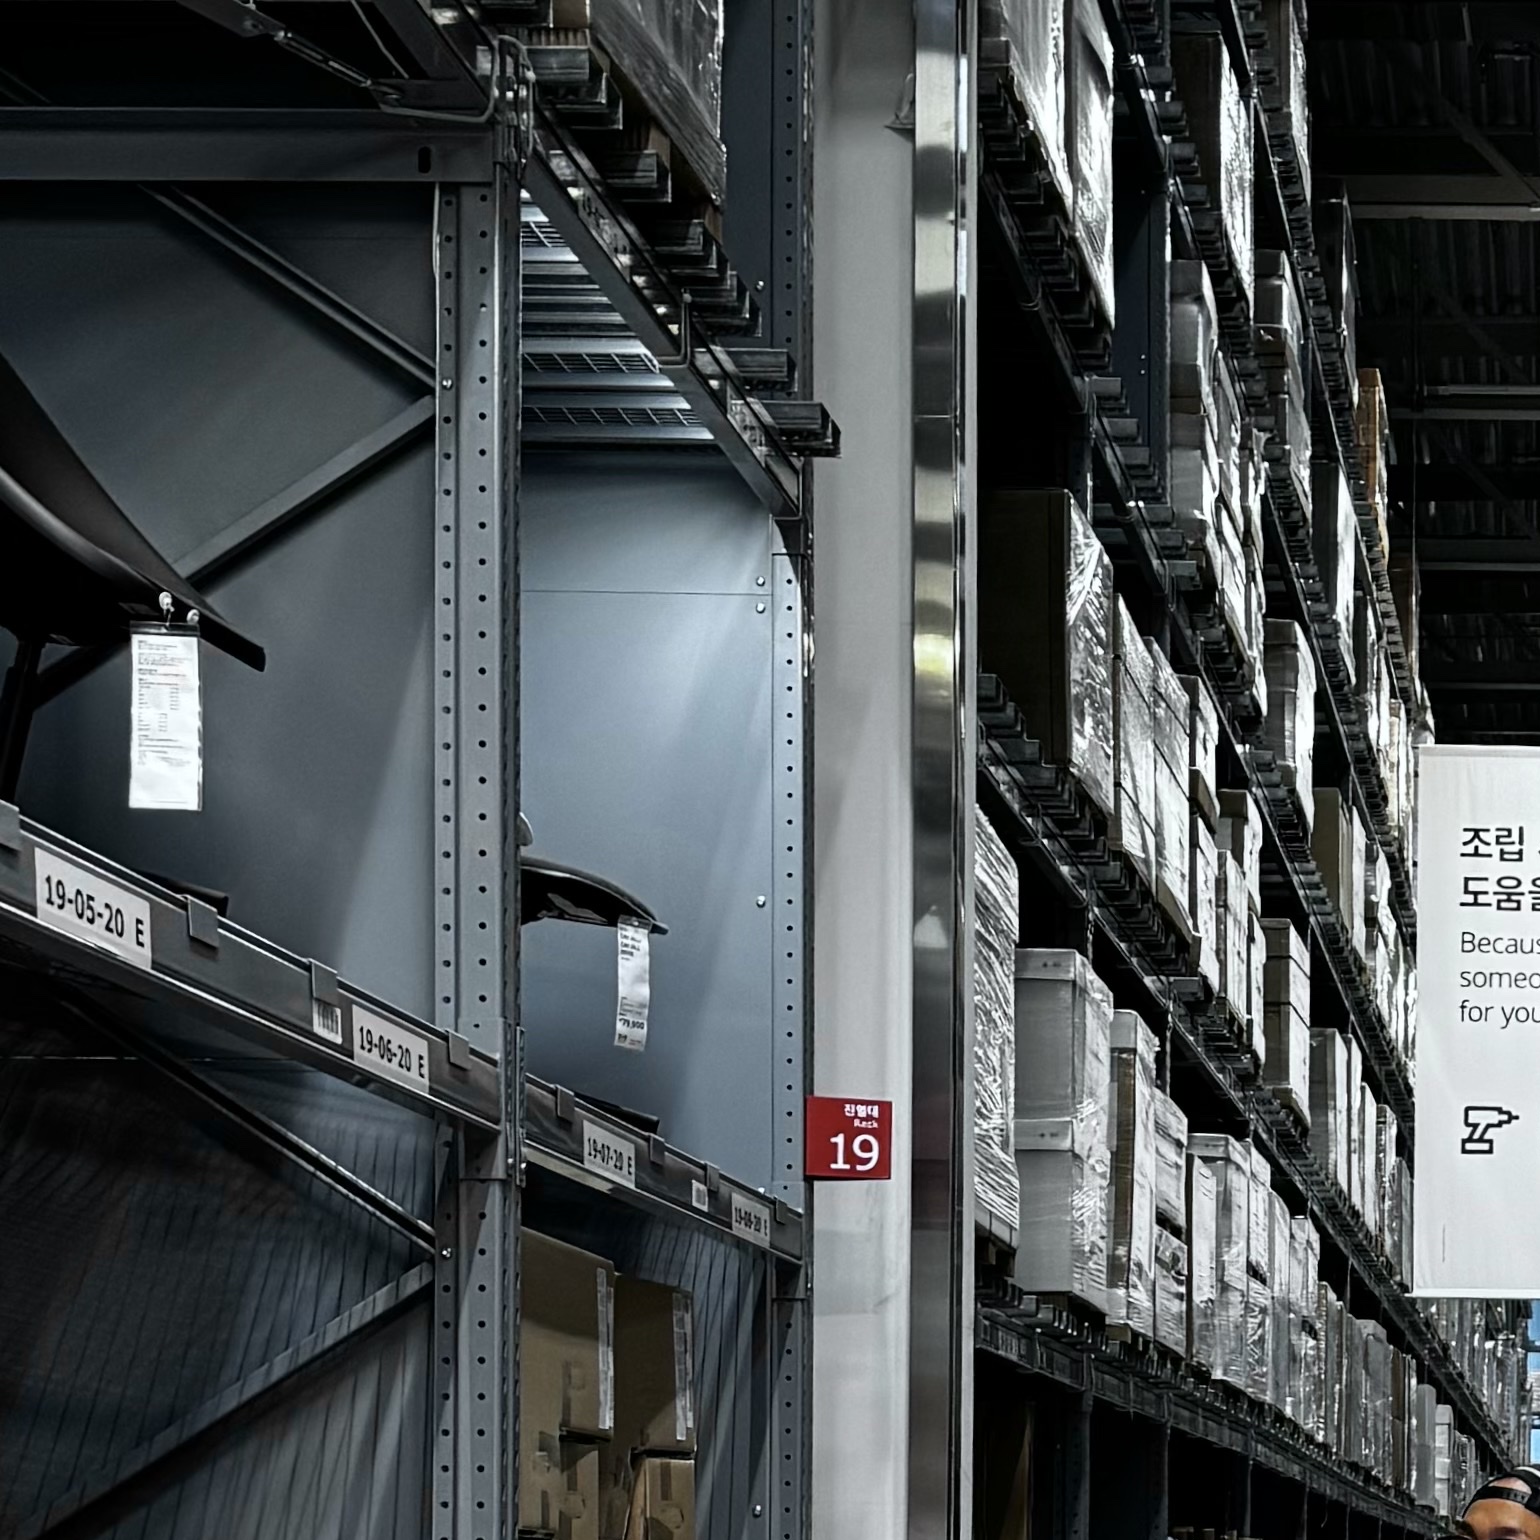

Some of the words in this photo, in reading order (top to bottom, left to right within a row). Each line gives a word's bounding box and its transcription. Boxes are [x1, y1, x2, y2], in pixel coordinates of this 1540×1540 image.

[1459, 826, 1525, 863] 조립
[45, 874, 125, 938] 19-05-20
[135, 917, 145, 948] E
[1459, 999, 1494, 1023] for
[359, 1025, 412, 1072] 19-06-20
[418, 1054, 425, 1079] E
[829, 1132, 880, 1172] 19
